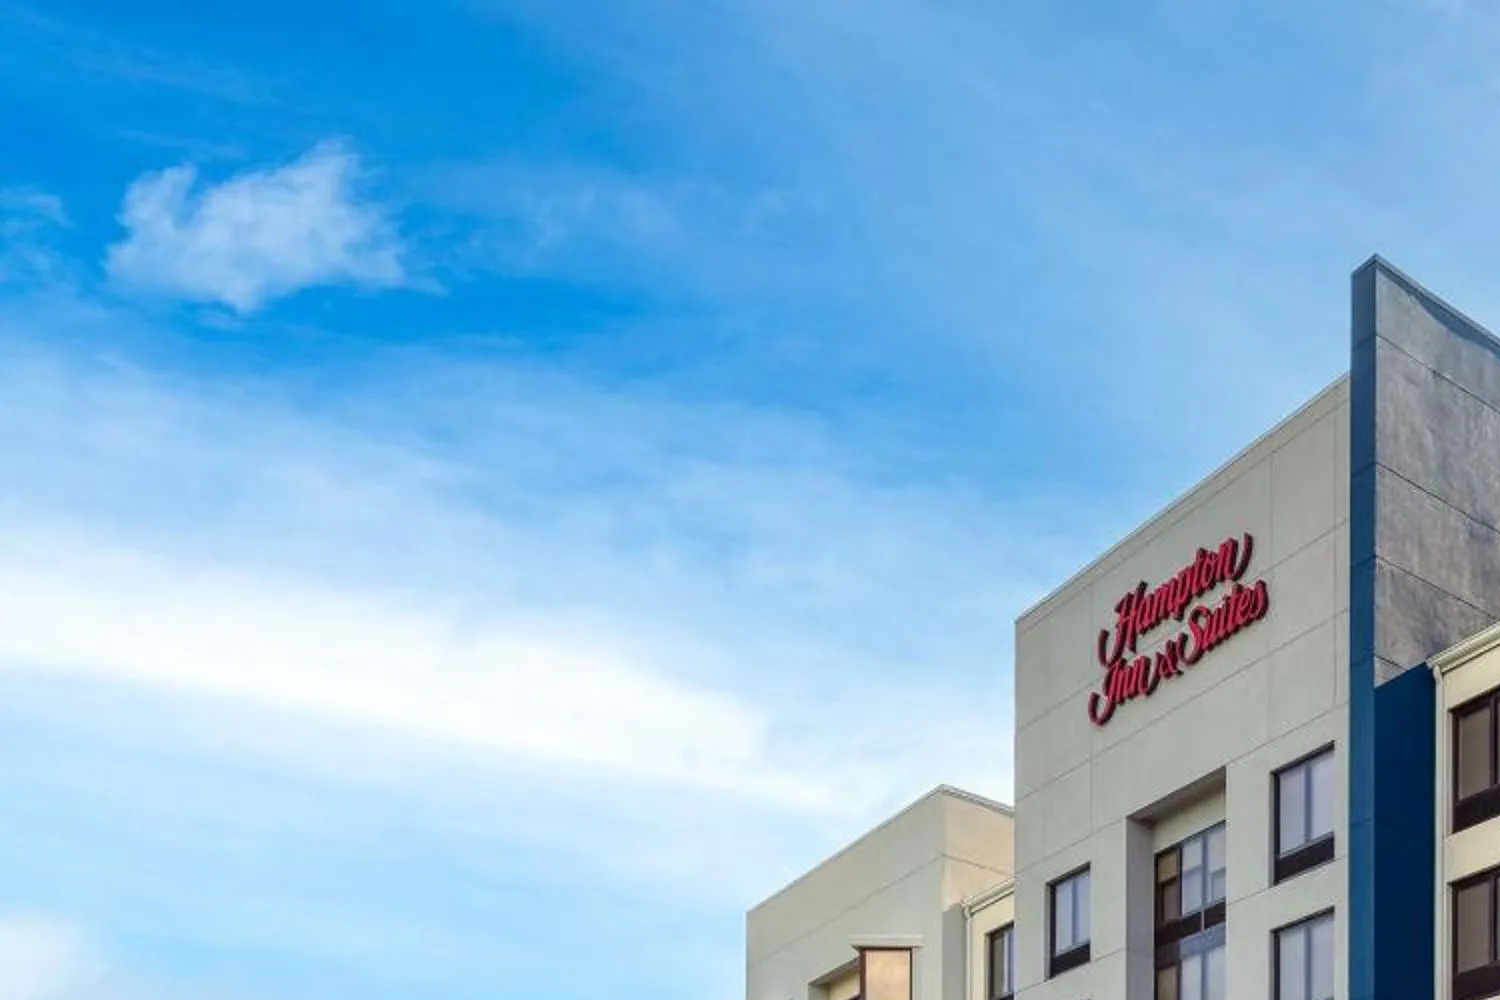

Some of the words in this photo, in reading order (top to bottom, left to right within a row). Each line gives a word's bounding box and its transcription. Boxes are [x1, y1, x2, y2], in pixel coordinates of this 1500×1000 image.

[1088, 652, 1161, 726] Inn
[1178, 579, 1269, 666] Suites
[1098, 533, 1254, 666] Hampton
